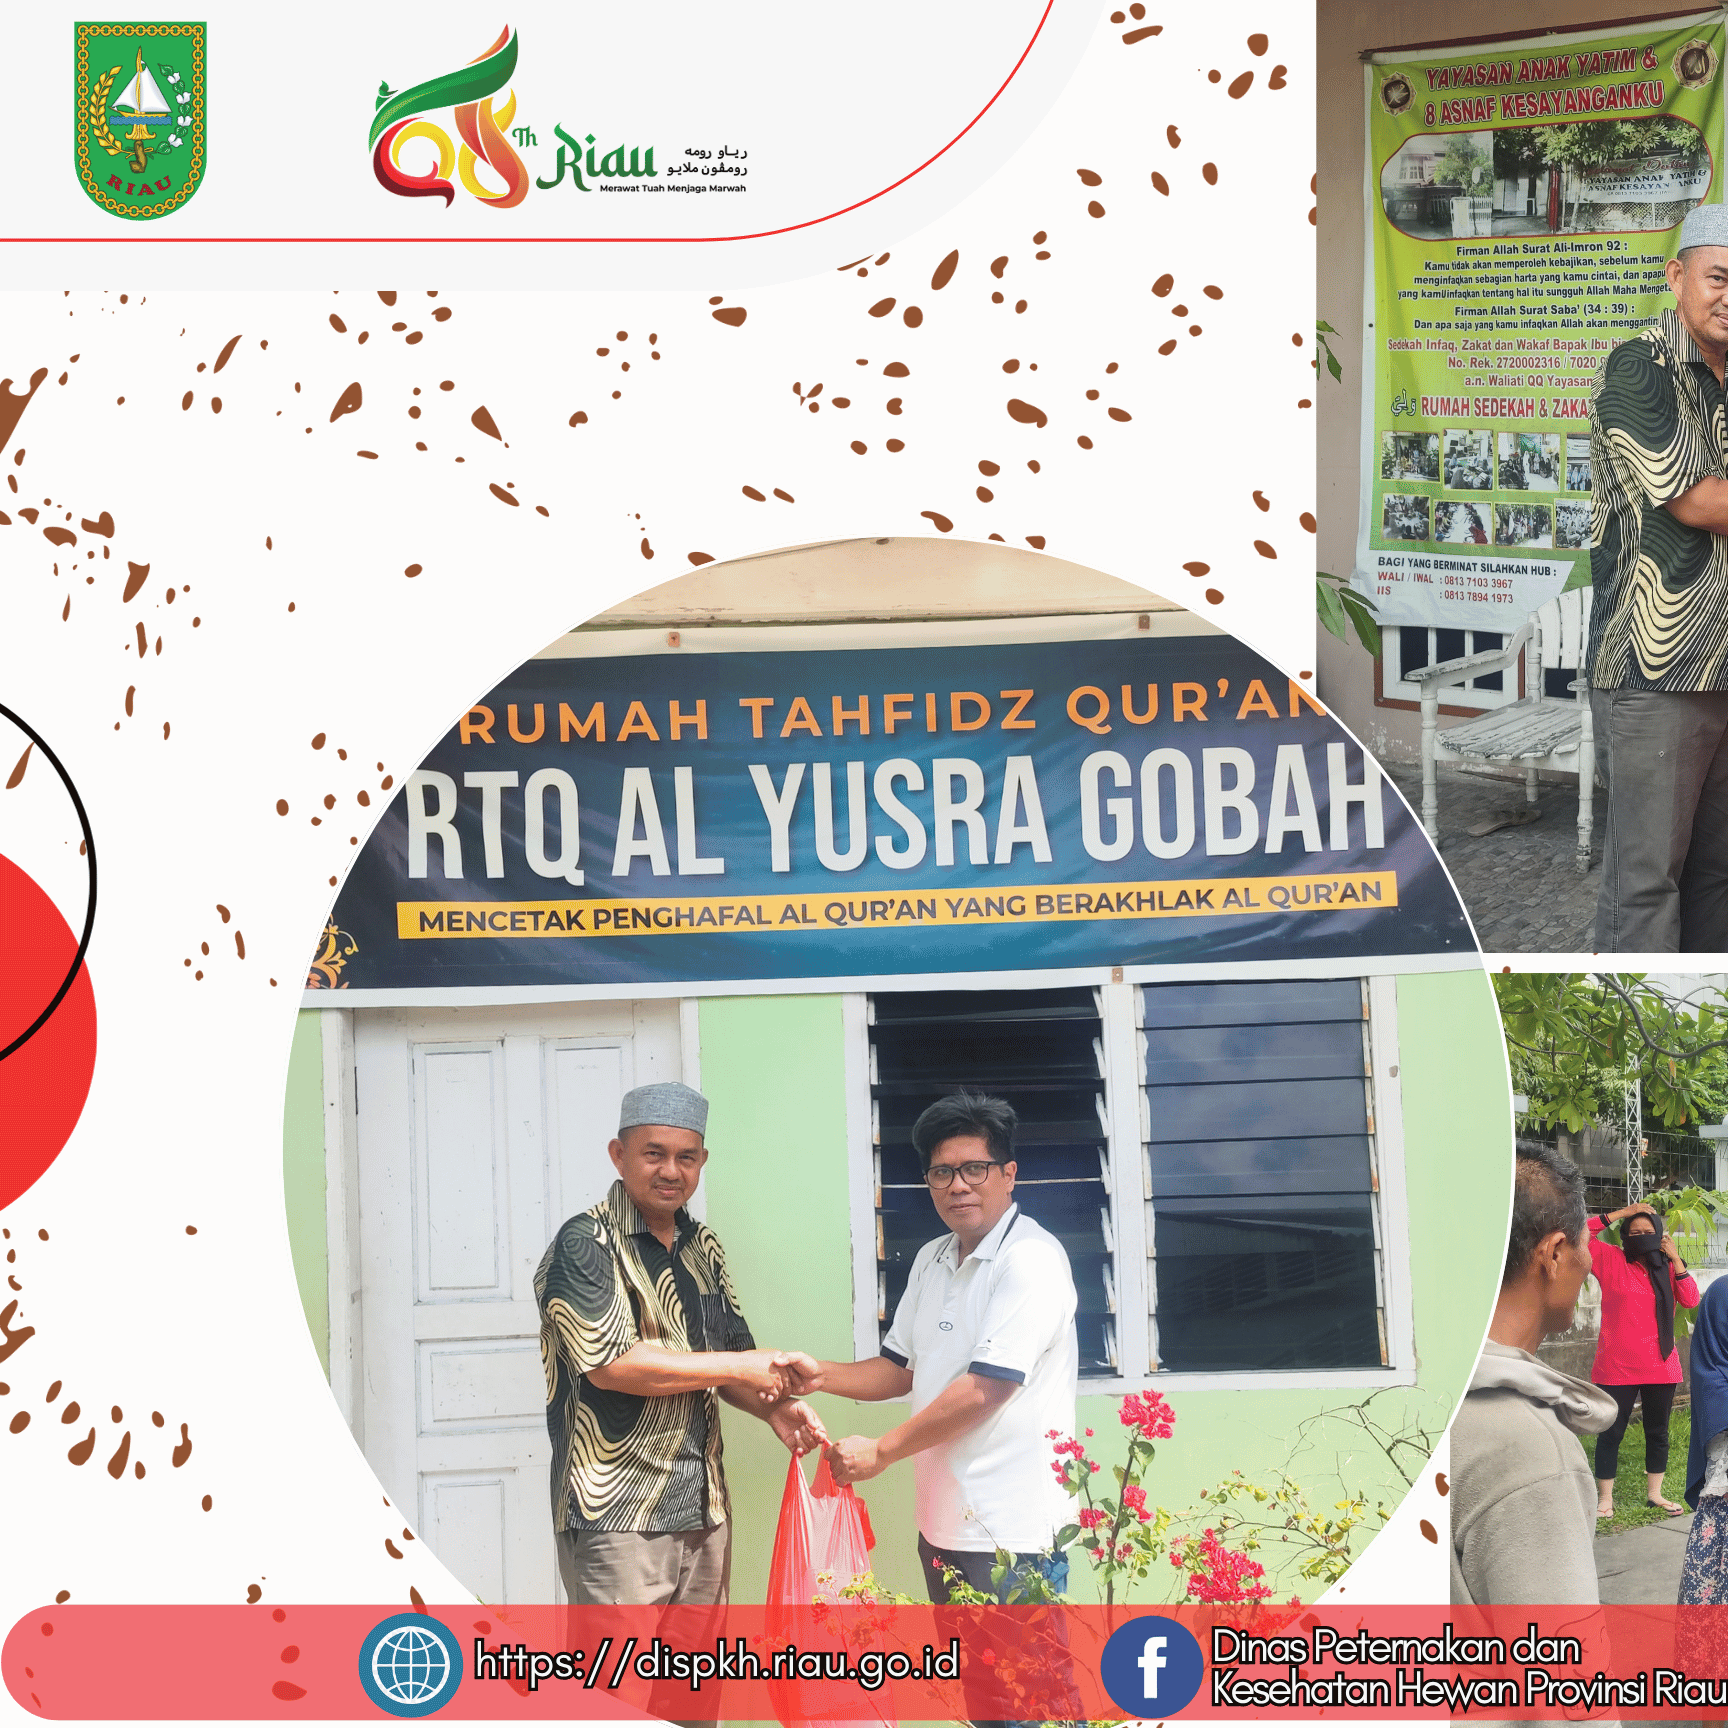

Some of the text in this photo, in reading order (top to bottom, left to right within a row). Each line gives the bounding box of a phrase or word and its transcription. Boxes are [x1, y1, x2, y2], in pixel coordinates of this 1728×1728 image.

[1426, 45, 1658, 90] YAYASAN ANAK YATIM &
[1424, 81, 1665, 126] 8 ASNAF KESAYANGANKU
[1457, 241, 1621, 257] Firman Allah Surat Ali-Imron 92
[1424, 254, 1664, 271] Kamu tidak akan memperoleh kebajikan, sebelum kamu
[1414, 275, 1473, 287] menginfaqkan
[1475, 274, 1512, 285] sebagian
[1514, 272, 1537, 282] harta
[1540, 274, 1560, 285] yang
[1563, 271, 1589, 281] kamu
[1591, 270, 1620, 282] cintai,
[1623, 270, 1639, 279] dan
[1398, 290, 1418, 300] yang
[1482, 287, 1514, 299] tentang
[1517, 287, 1529, 297] hal
[1532, 287, 1543, 296] itu
[1546, 286, 1584, 298] sungguh
[1586, 285, 1610, 295] Allah
[1612, 284, 1637, 294] Maha
[1455, 306, 1488, 317] Firman
[1490, 305, 1516, 316] Allah
[1519, 304, 1547, 315] Surat
[1414, 320, 1433, 330] Dan
[1435, 322, 1452, 332] apa
[1454, 320, 1472, 331] saja
[1474, 322, 1494, 332] yang
[1495, 319, 1518, 329] kamu
[1520, 319, 1558, 331] infaqkan
[1560, 318, 1583, 328] Allah
[1586, 318, 1608, 328] akan
[1388, 339, 1422, 350] Sedekah
[1426, 338, 1457, 352] Infaq,
[1462, 339, 1492, 350] Zakat
[1494, 339, 1513, 350] dan
[1516, 338, 1550, 350] Wakaf
[1553, 338, 1587, 353] Bapak
[1591, 338, 1608, 350] Ibu
[1448, 357, 1466, 369] No.
[1470, 357, 1494, 369] Rek.
[1496, 357, 1561, 369] 2720002316
[1570, 357, 1597, 369] 7020
[1465, 375, 1593, 389] a.n. Waliati QQ Yayasan
[1421, 397, 1591, 418] RUMAH SEDEKAH & ZAKA
[1378, 557, 1550, 576] BAGI YANG BERMINAT SILAHKAN HUB
[1378, 571, 1404, 582] WALI
[1413, 573, 1433, 584] IWAL
[1444, 575, 1464, 586] 0813
[1467, 577, 1488, 588] 7103
[1491, 579, 1513, 589] 3967
[1444, 590, 1465, 600] 0813
[1467, 592, 1488, 602] 7894
[1491, 594, 1513, 604] 1973
[459, 699, 708, 745] RUMAH
[739, 688, 1036, 739] TAHFIDZ
[405, 742, 1386, 886] RTQ AL YUSRA GOBAH
[419, 908, 584, 933] MENCETAK
[593, 904, 772, 930] PENGHAFAL
[779, 903, 817, 925] AL
[944, 894, 1026, 919] YANG
[1036, 888, 1214, 916] BERAKHLAK
[1222, 887, 1260, 909] AL
